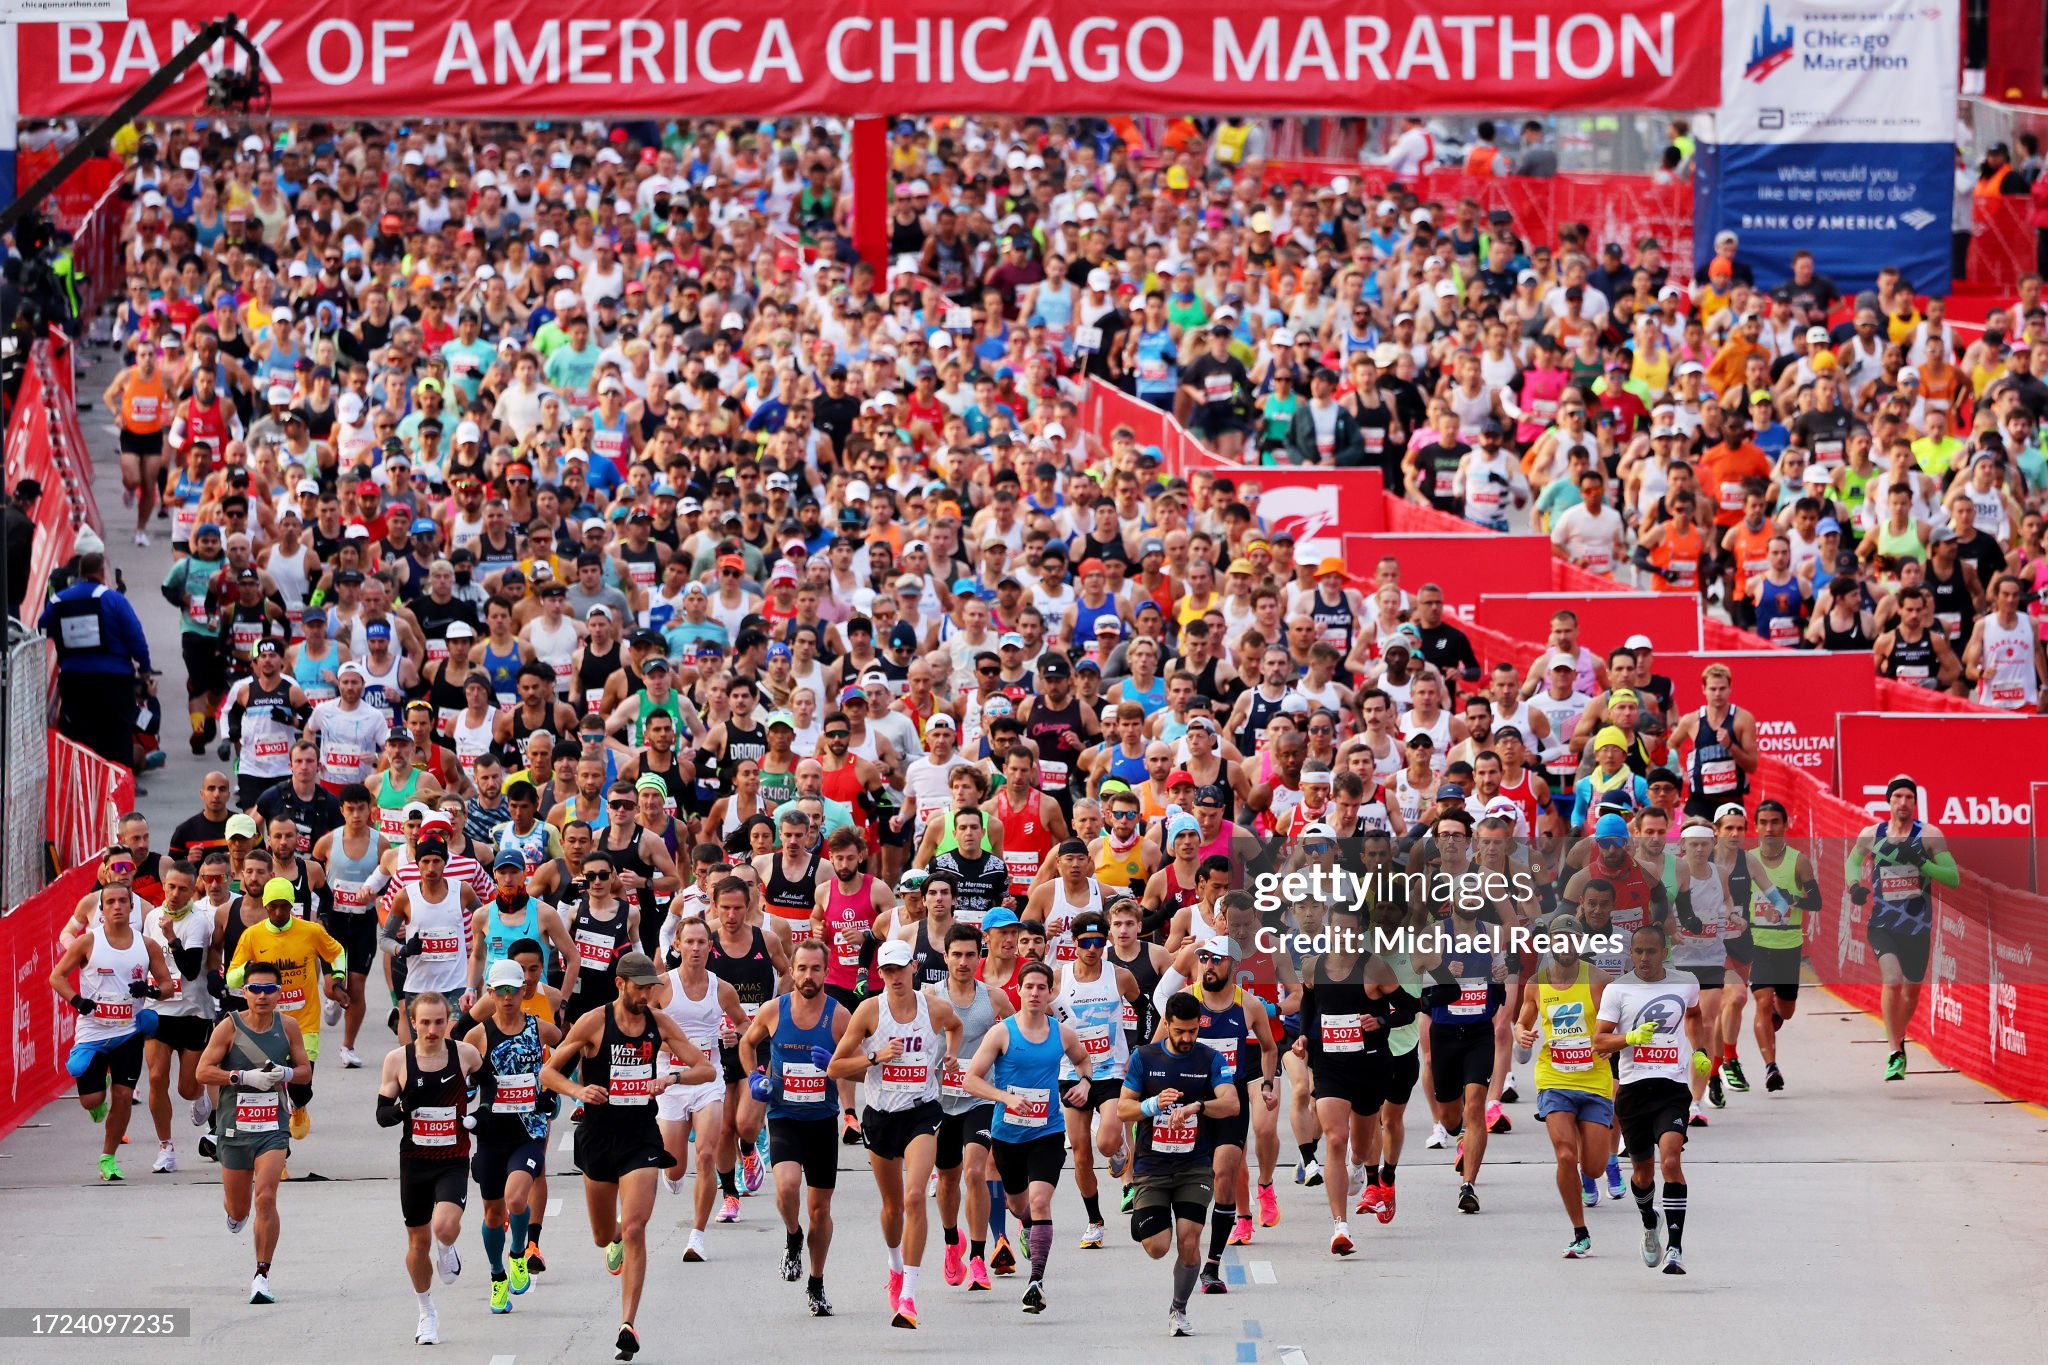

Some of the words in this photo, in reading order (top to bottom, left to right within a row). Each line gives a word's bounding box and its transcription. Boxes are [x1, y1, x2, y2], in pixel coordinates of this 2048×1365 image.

[21, 0, 111, 9] chicagomarathon.com
[1803, 29, 1890, 51] Chicago
[57, 19, 283, 84] BANK
[306, 18, 415, 85] OF
[434, 18, 803, 85] AMERICA
[825, 16, 1184, 83] CHICAGO
[1211, 13, 1675, 82] MARATHON
[1803, 53, 1908, 71] Marathon
[1778, 166, 1817, 182] What
[1821, 166, 1867, 182] would
[1870, 169, 1898, 185] you
[1758, 184, 1784, 200] like
[1787, 184, 1813, 200] the
[1816, 187, 1863, 204] power
[1867, 186, 1885, 201] to
[1887, 183, 1917, 201] do?
[1742, 215, 1789, 229] BANK
[1792, 215, 1815, 229] OF
[1818, 215, 1898, 230] AMERICA
[1756, 736, 1835, 752] ONSULTA
[1012, 864, 1038, 873] 25440
[422, 941, 429, 949] A
[431, 940, 458, 950] 3169
[584, 944, 611, 958] 3196
[281, 989, 303, 1000] 1081
[1072, 997, 1108, 1005] ARGENTINA
[95, 1003, 103, 1014] A
[106, 1004, 131, 1015] 1010
[1323, 1030, 1330, 1038] A
[1332, 1029, 1361, 1039] 5073
[610, 1043, 637, 1056] WEST
[889, 1036, 923, 1053] TC
[1552, 1051, 1559, 1059] A
[1561, 1050, 1591, 1060] 10030
[1635, 1049, 1643, 1058] A
[1648, 1050, 1678, 1060] 4070
[610, 1056, 642, 1066] VALLEY
[884, 1068, 890, 1076] A
[893, 1068, 926, 1077] 20158
[611, 1081, 618, 1090] A
[785, 1079, 792, 1087] A
[793, 1078, 825, 1088] 21063
[503, 1089, 534, 1099] 25284
[238, 1108, 245, 1117] A
[247, 1107, 277, 1117] 20115
[413, 1121, 420, 1130] A
[424, 1121, 455, 1131] 18054
[1153, 1128, 1161, 1138] A
[1167, 1128, 1195, 1139] 1122
